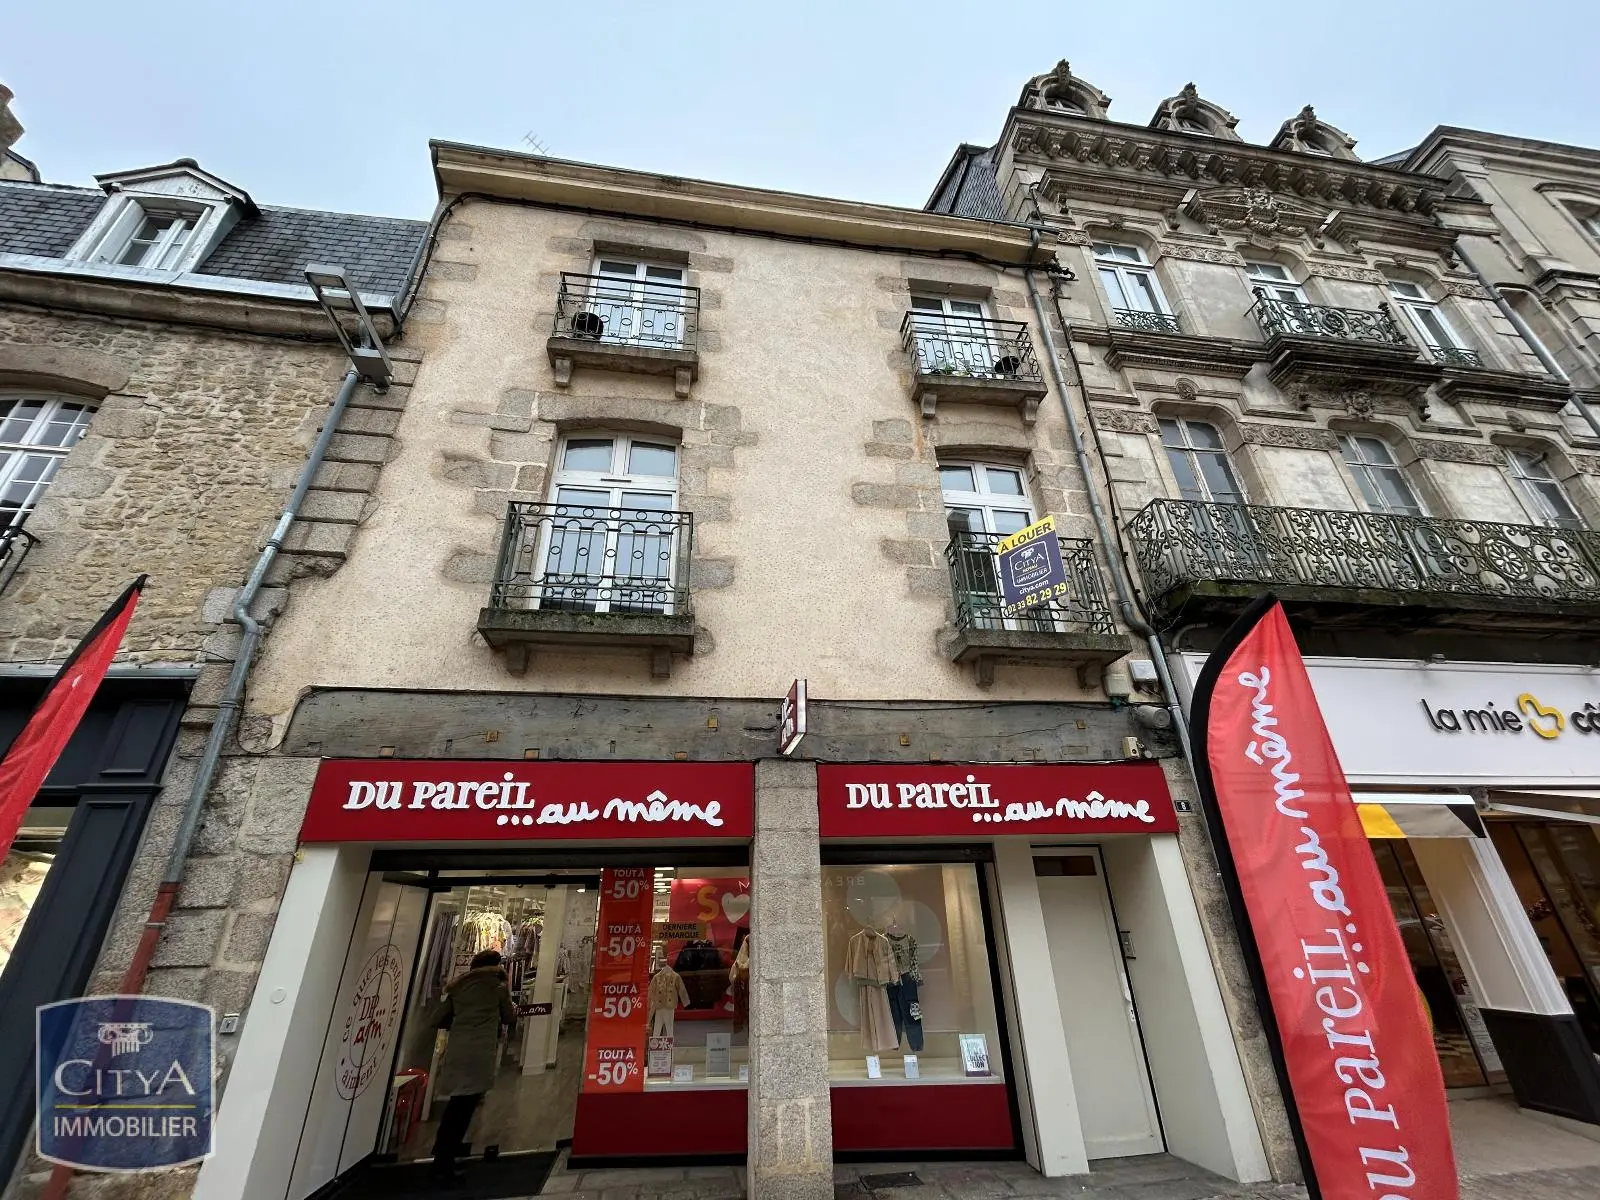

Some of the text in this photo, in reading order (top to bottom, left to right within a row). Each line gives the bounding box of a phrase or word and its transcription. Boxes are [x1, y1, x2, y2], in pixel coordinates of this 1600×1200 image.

[1011, 522, 1052, 547] LOUER
[1017, 600, 1026, 610] 33
[1026, 593, 1039, 606] 82
[1039, 587, 1052, 601] 29
[1053, 582, 1067, 596] 29
[1019, 579, 1049, 595] citya.com
[1420, 698, 1462, 731] la
[1462, 701, 1524, 732] mie
[1238, 666, 1308, 819] même
[603, 790, 724, 827] même
[1055, 791, 1156, 823] même
[613, 868, 638, 878] TOUT
[605, 879, 650, 899] -50%
[608, 924, 634, 934] TOUT
[600, 936, 646, 957] -50%
[603, 983, 638, 995] TOUT À
[594, 996, 642, 1018] -50%
[598, 1047, 635, 1060] TOUT À
[588, 1060, 639, 1085] -50%
